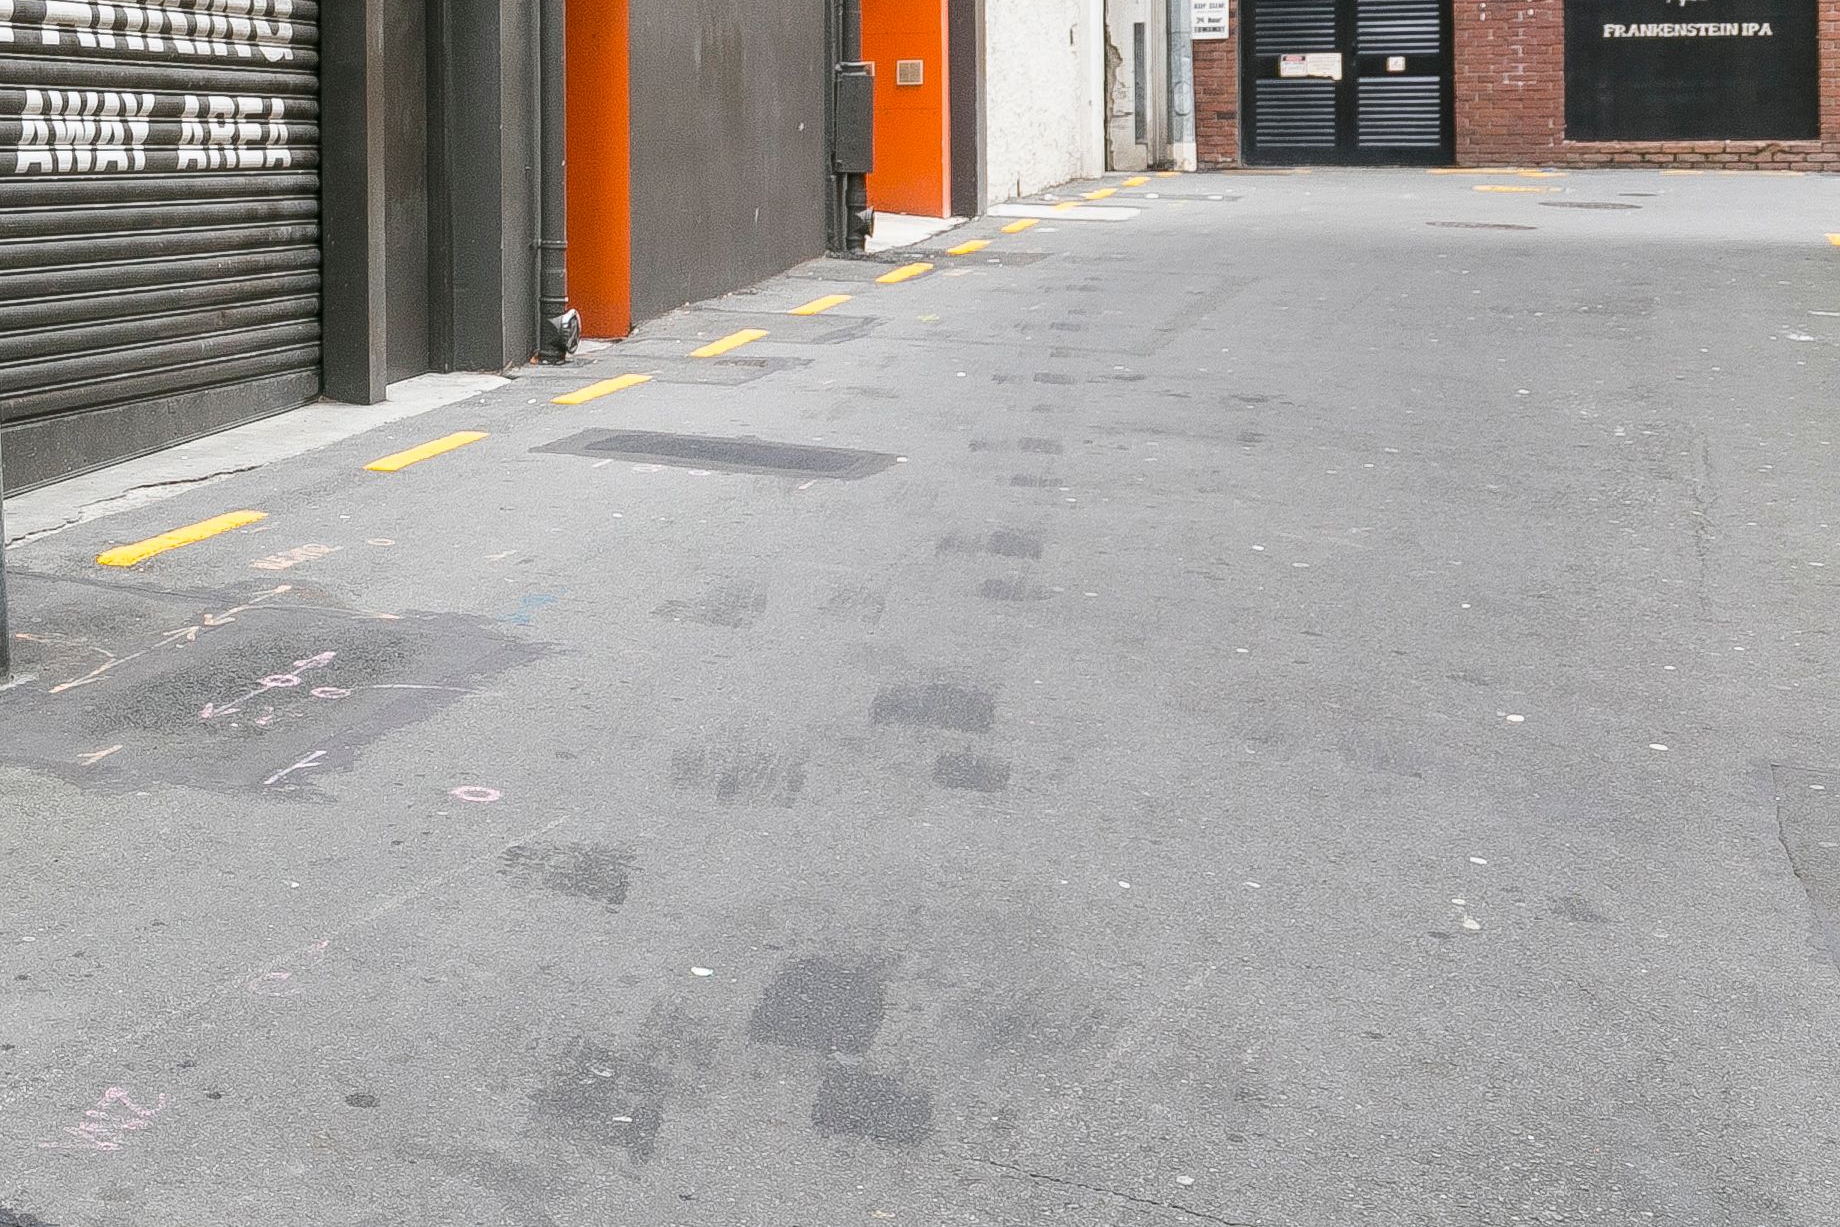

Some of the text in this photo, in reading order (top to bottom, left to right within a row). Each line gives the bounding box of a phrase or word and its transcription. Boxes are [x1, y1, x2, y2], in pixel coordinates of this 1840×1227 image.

[1602, 22, 1773, 38] FRANKENSTEIN IPA
[14, 89, 157, 175] AWAY
[175, 94, 292, 171] AREA
